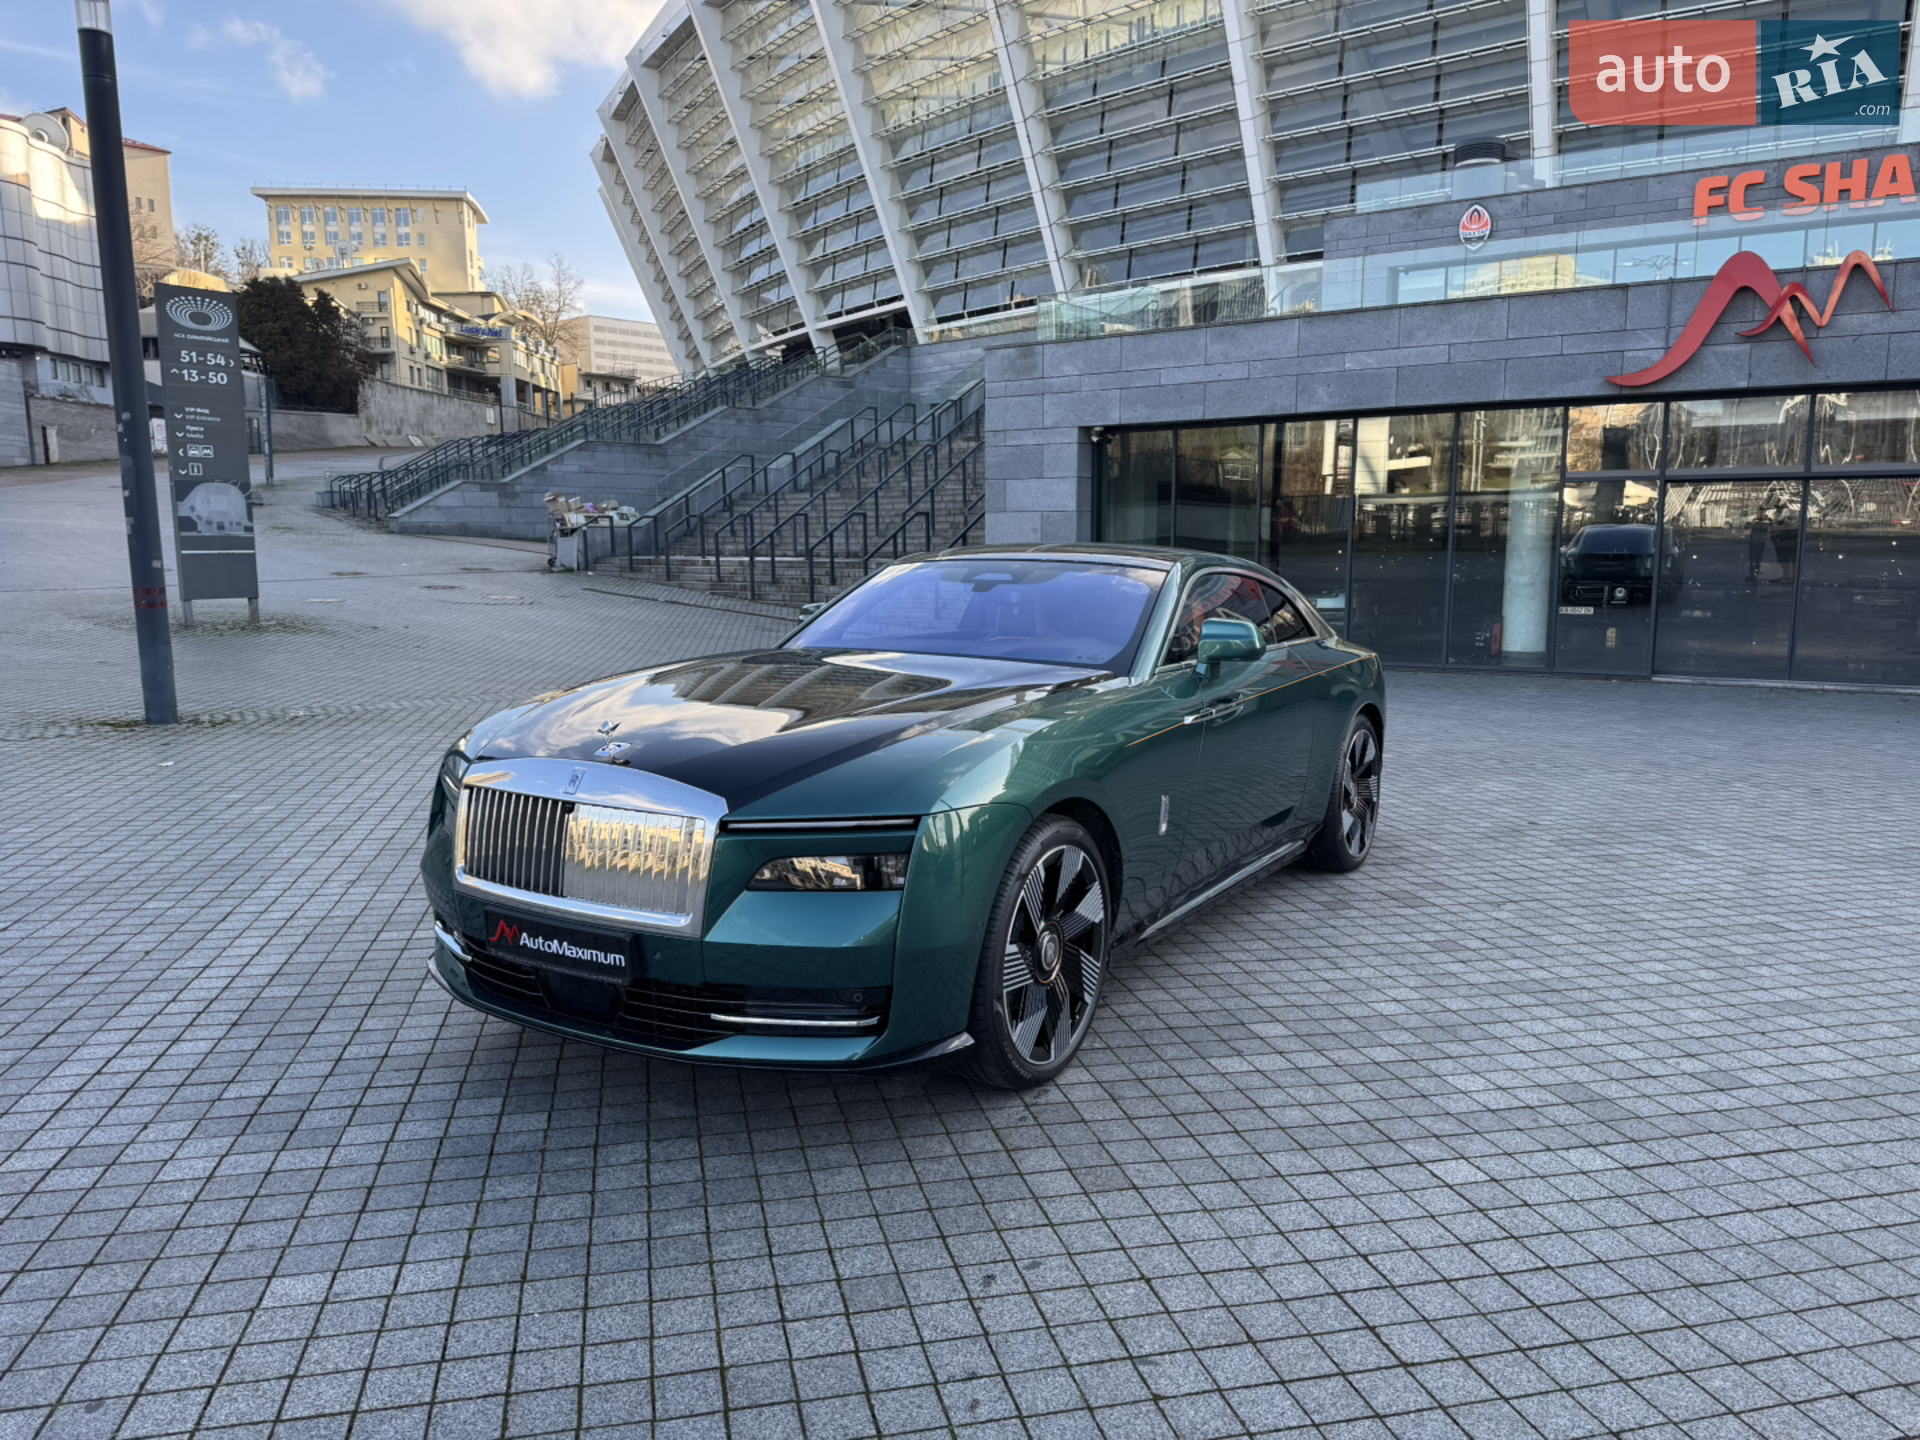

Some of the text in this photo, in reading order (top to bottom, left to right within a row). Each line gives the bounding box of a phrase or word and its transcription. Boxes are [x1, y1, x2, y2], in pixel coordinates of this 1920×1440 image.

[1693, 154, 1918, 226] FC SHA
[519, 932, 626, 967] AutoMaximum
